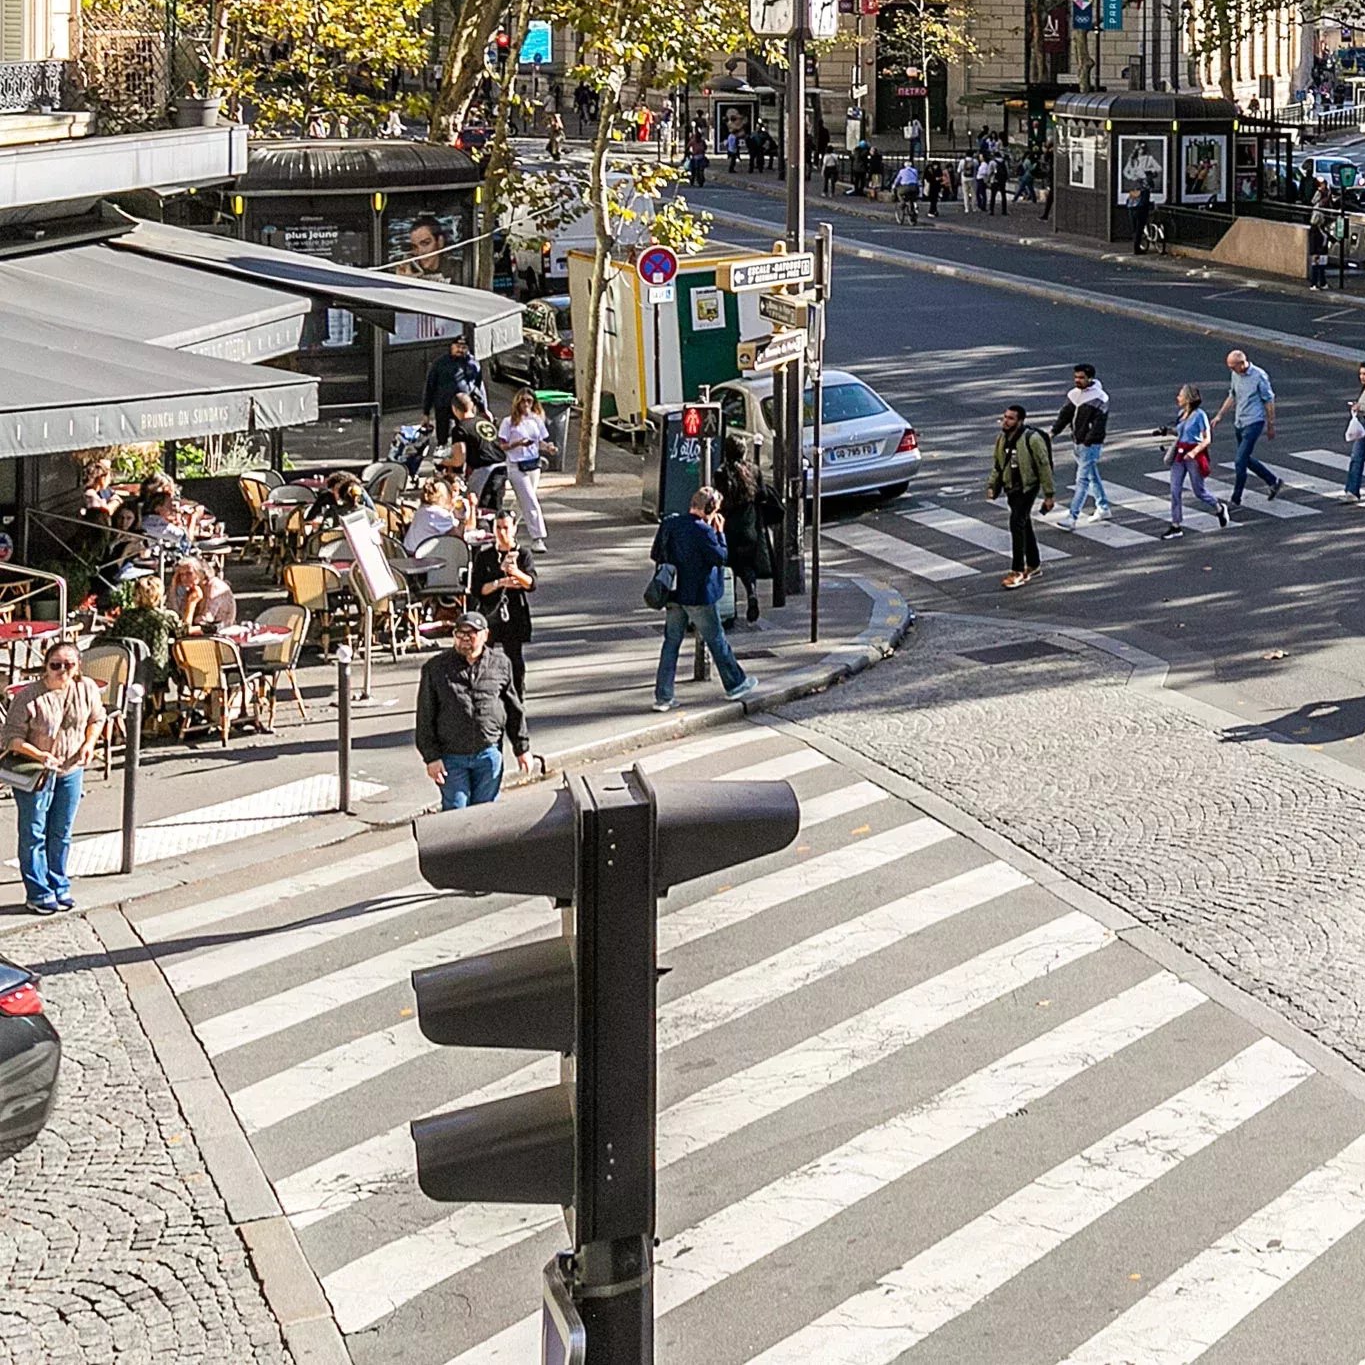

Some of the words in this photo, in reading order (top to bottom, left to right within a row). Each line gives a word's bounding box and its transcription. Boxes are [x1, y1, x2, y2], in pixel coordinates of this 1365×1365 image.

[141, 413, 174, 430] BRUNCH
[178, 410, 189, 426] ON
[193, 406, 229, 424] SUNDAYS
